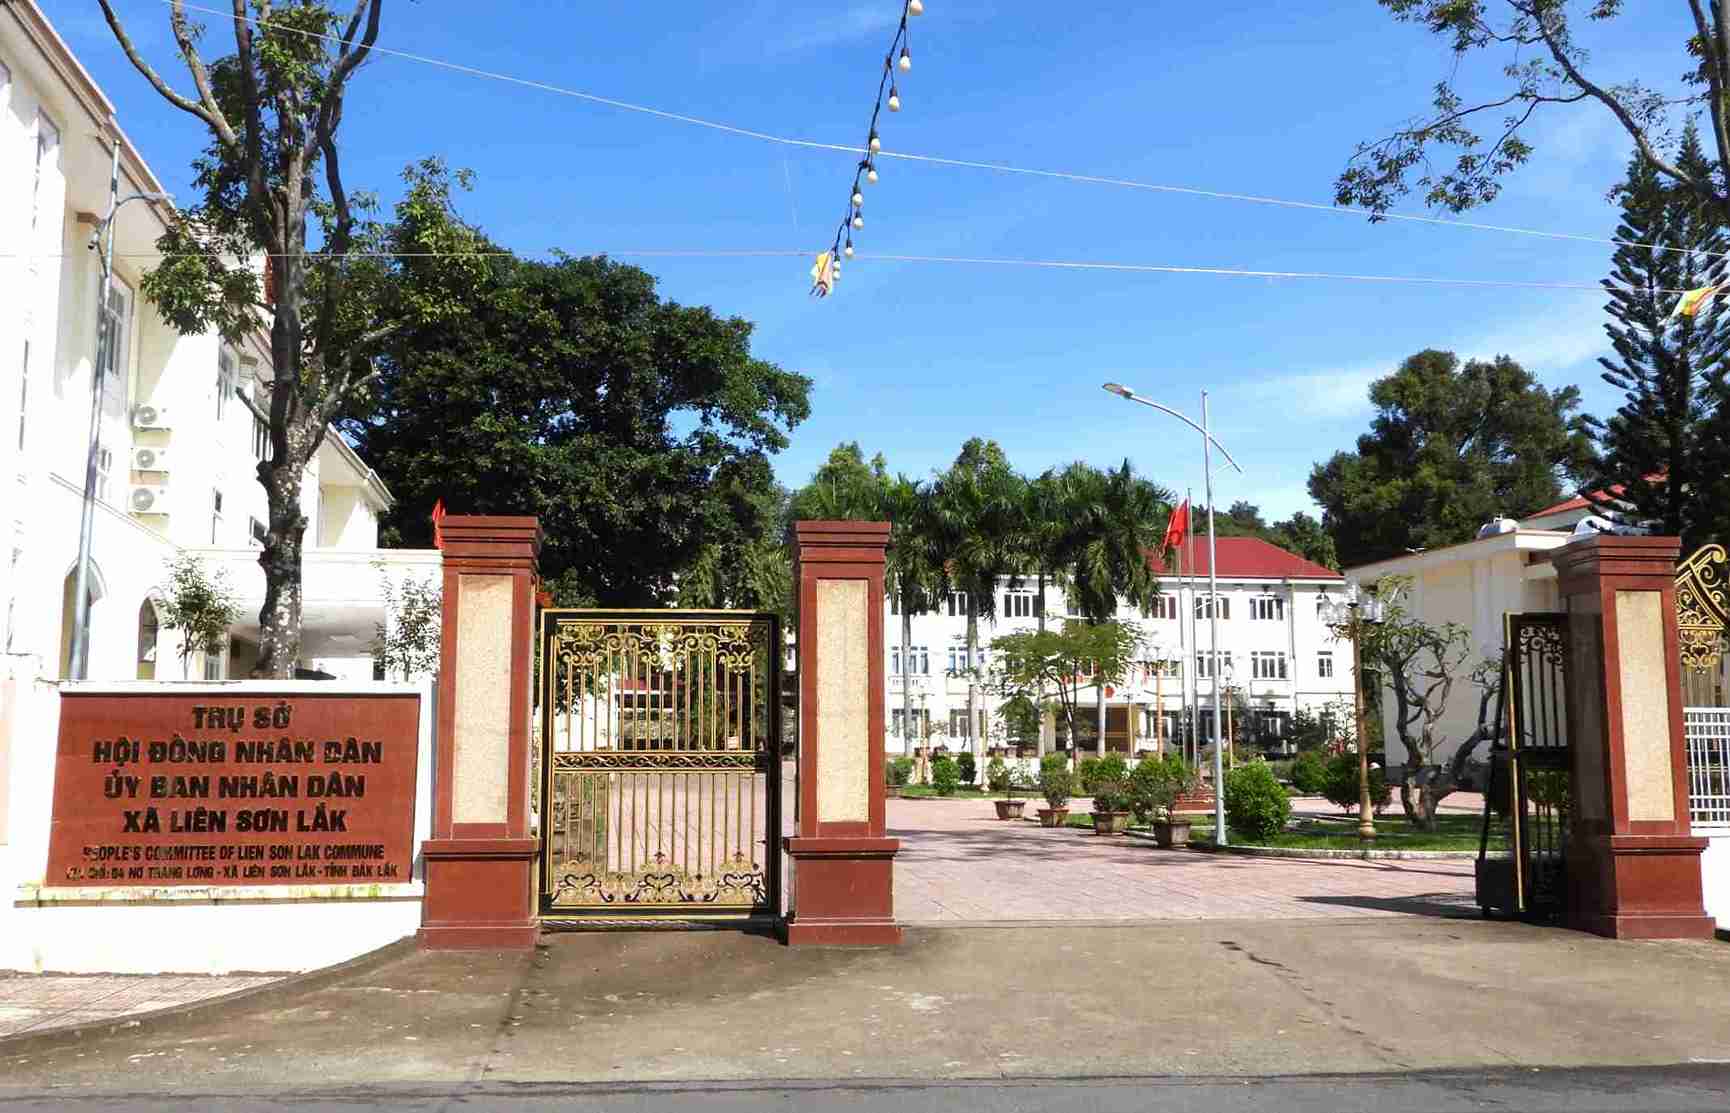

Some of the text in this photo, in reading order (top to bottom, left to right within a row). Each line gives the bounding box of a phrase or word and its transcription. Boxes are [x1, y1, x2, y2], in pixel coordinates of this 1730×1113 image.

[192, 700, 292, 732] TRỤ SỞ
[94, 732, 382, 767] HỘI ĐỒNG NHÂN DÂN
[104, 769, 365, 798] ỦY BAN NHÂN DÂN
[171, 805, 226, 832] LIÊN
[235, 808, 288, 832] SƠN
[297, 801, 348, 832] LẮK
[145, 845, 216, 861] COMMITTEE
[219, 845, 235, 860] OF
[238, 845, 265, 860] LIEN
[270, 845, 294, 860] SON
[297, 845, 321, 860] LAK
[324, 845, 385, 860] COMMUNE
